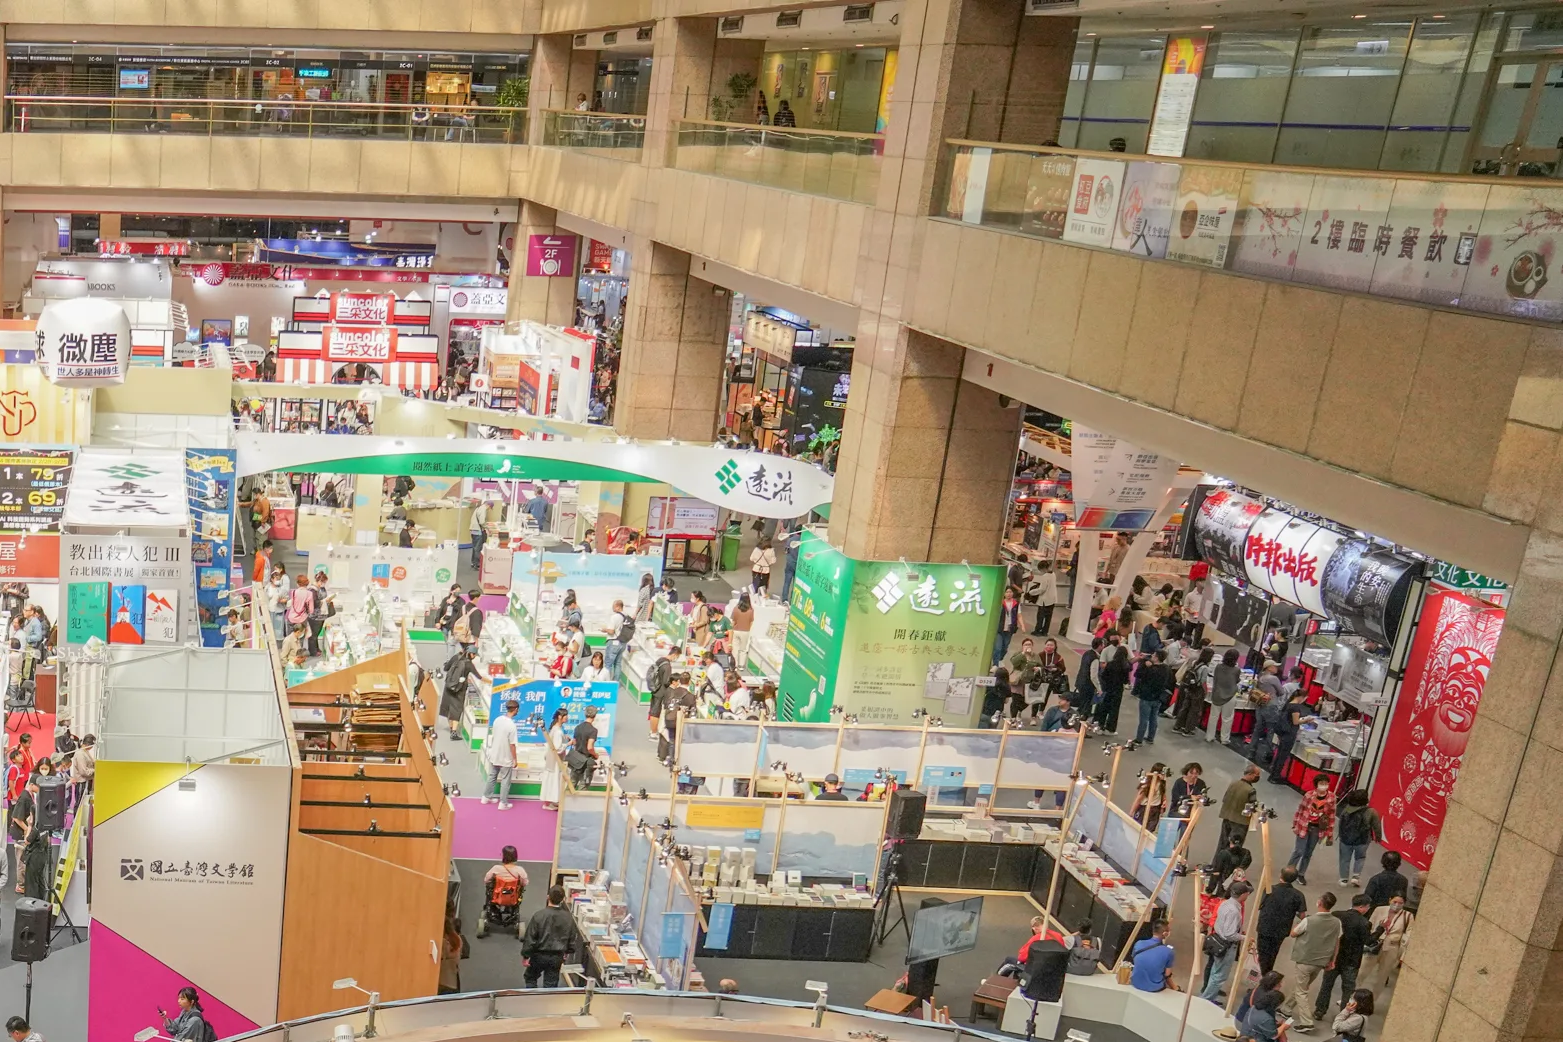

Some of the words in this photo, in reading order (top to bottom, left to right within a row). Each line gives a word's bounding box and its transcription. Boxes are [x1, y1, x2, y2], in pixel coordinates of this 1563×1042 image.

[544, 249, 558, 259] 2F
[701, 261, 707, 271] 1
[338, 307, 386, 320] 三采文化
[58, 332, 118, 364] 微塵
[331, 343, 387, 358] 三采文化
[57, 365, 120, 377] 世人多是神轉生
[986, 362, 994, 377] 1
[745, 467, 794, 505] 遠流
[69, 543, 159, 563] 教出殺人犯
[1246, 532, 1318, 587] 時報出版
[69, 566, 135, 579] 台北國際書展
[1433, 561, 1459, 585] 文化
[909, 574, 986, 616] 遠流
[893, 628, 948, 642] 開春鉅獻
[525, 691, 546, 702] 我們
[149, 859, 255, 879] 國立臺灣文學館
